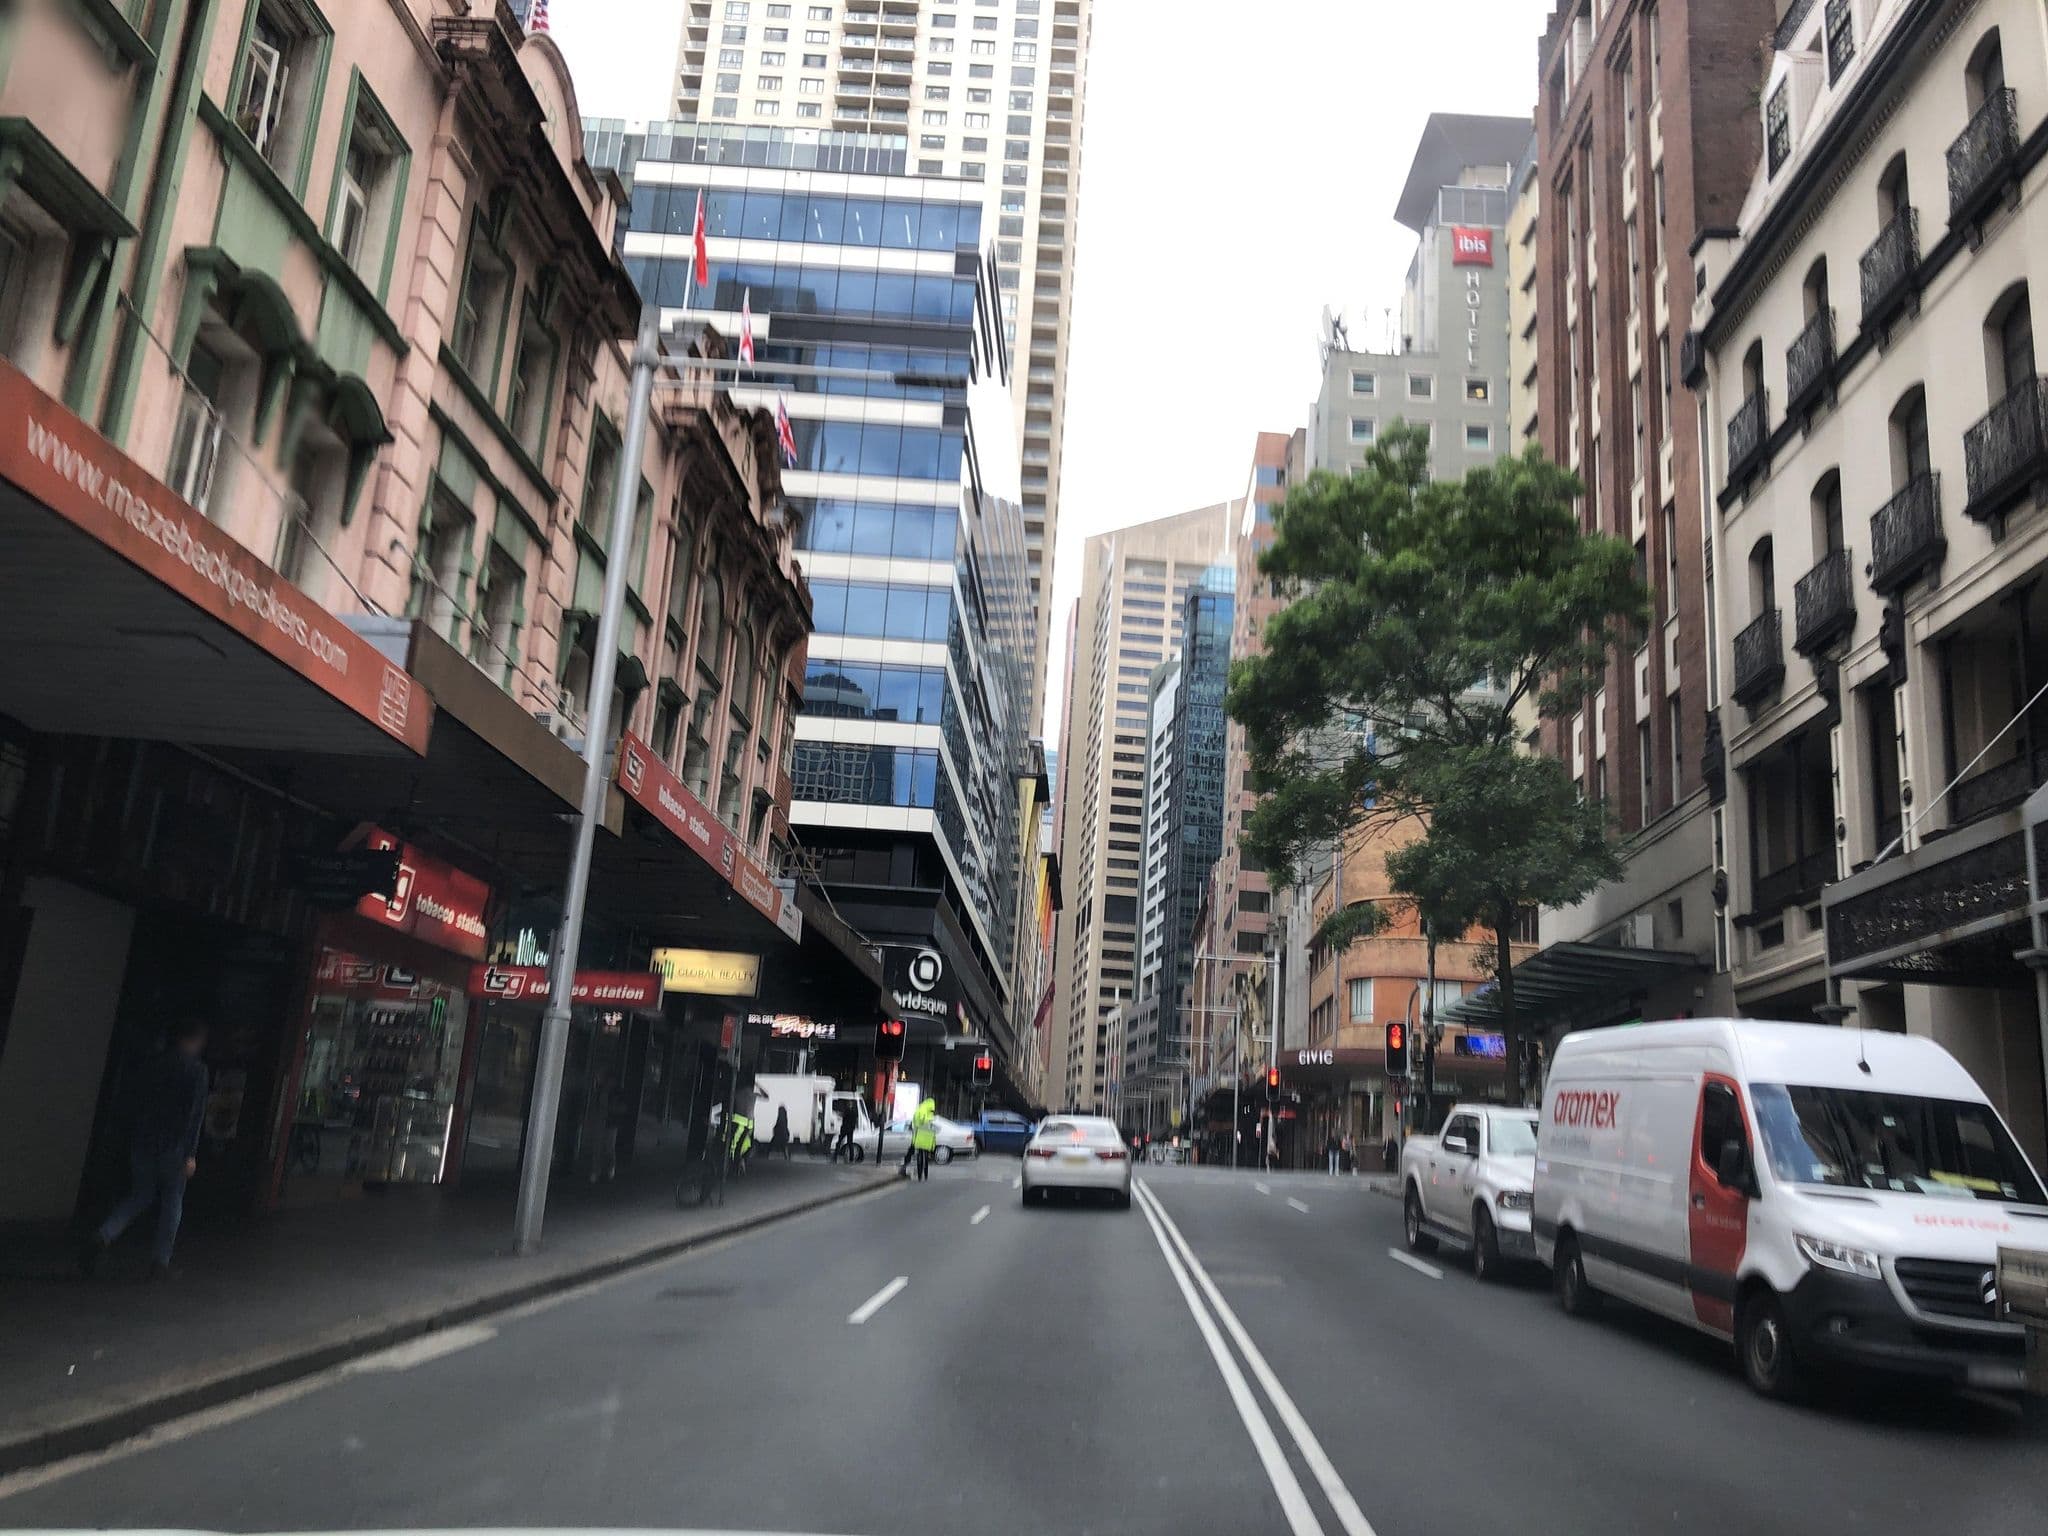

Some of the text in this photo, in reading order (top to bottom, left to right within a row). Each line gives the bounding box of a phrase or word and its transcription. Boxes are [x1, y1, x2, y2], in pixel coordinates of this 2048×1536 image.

[1459, 235, 1487, 253] ibis
[1466, 271, 1480, 368] HOTEL
[27, 415, 348, 676] www.mazebackpackers.com
[658, 784, 710, 847] tobacco station
[416, 893, 486, 939] tobacco station
[593, 985, 645, 1000] station
[677, 967, 756, 983] GLOBAL REALTY
[1298, 1049, 1334, 1066] CIVIC
[1553, 1088, 1620, 1129] aramex
